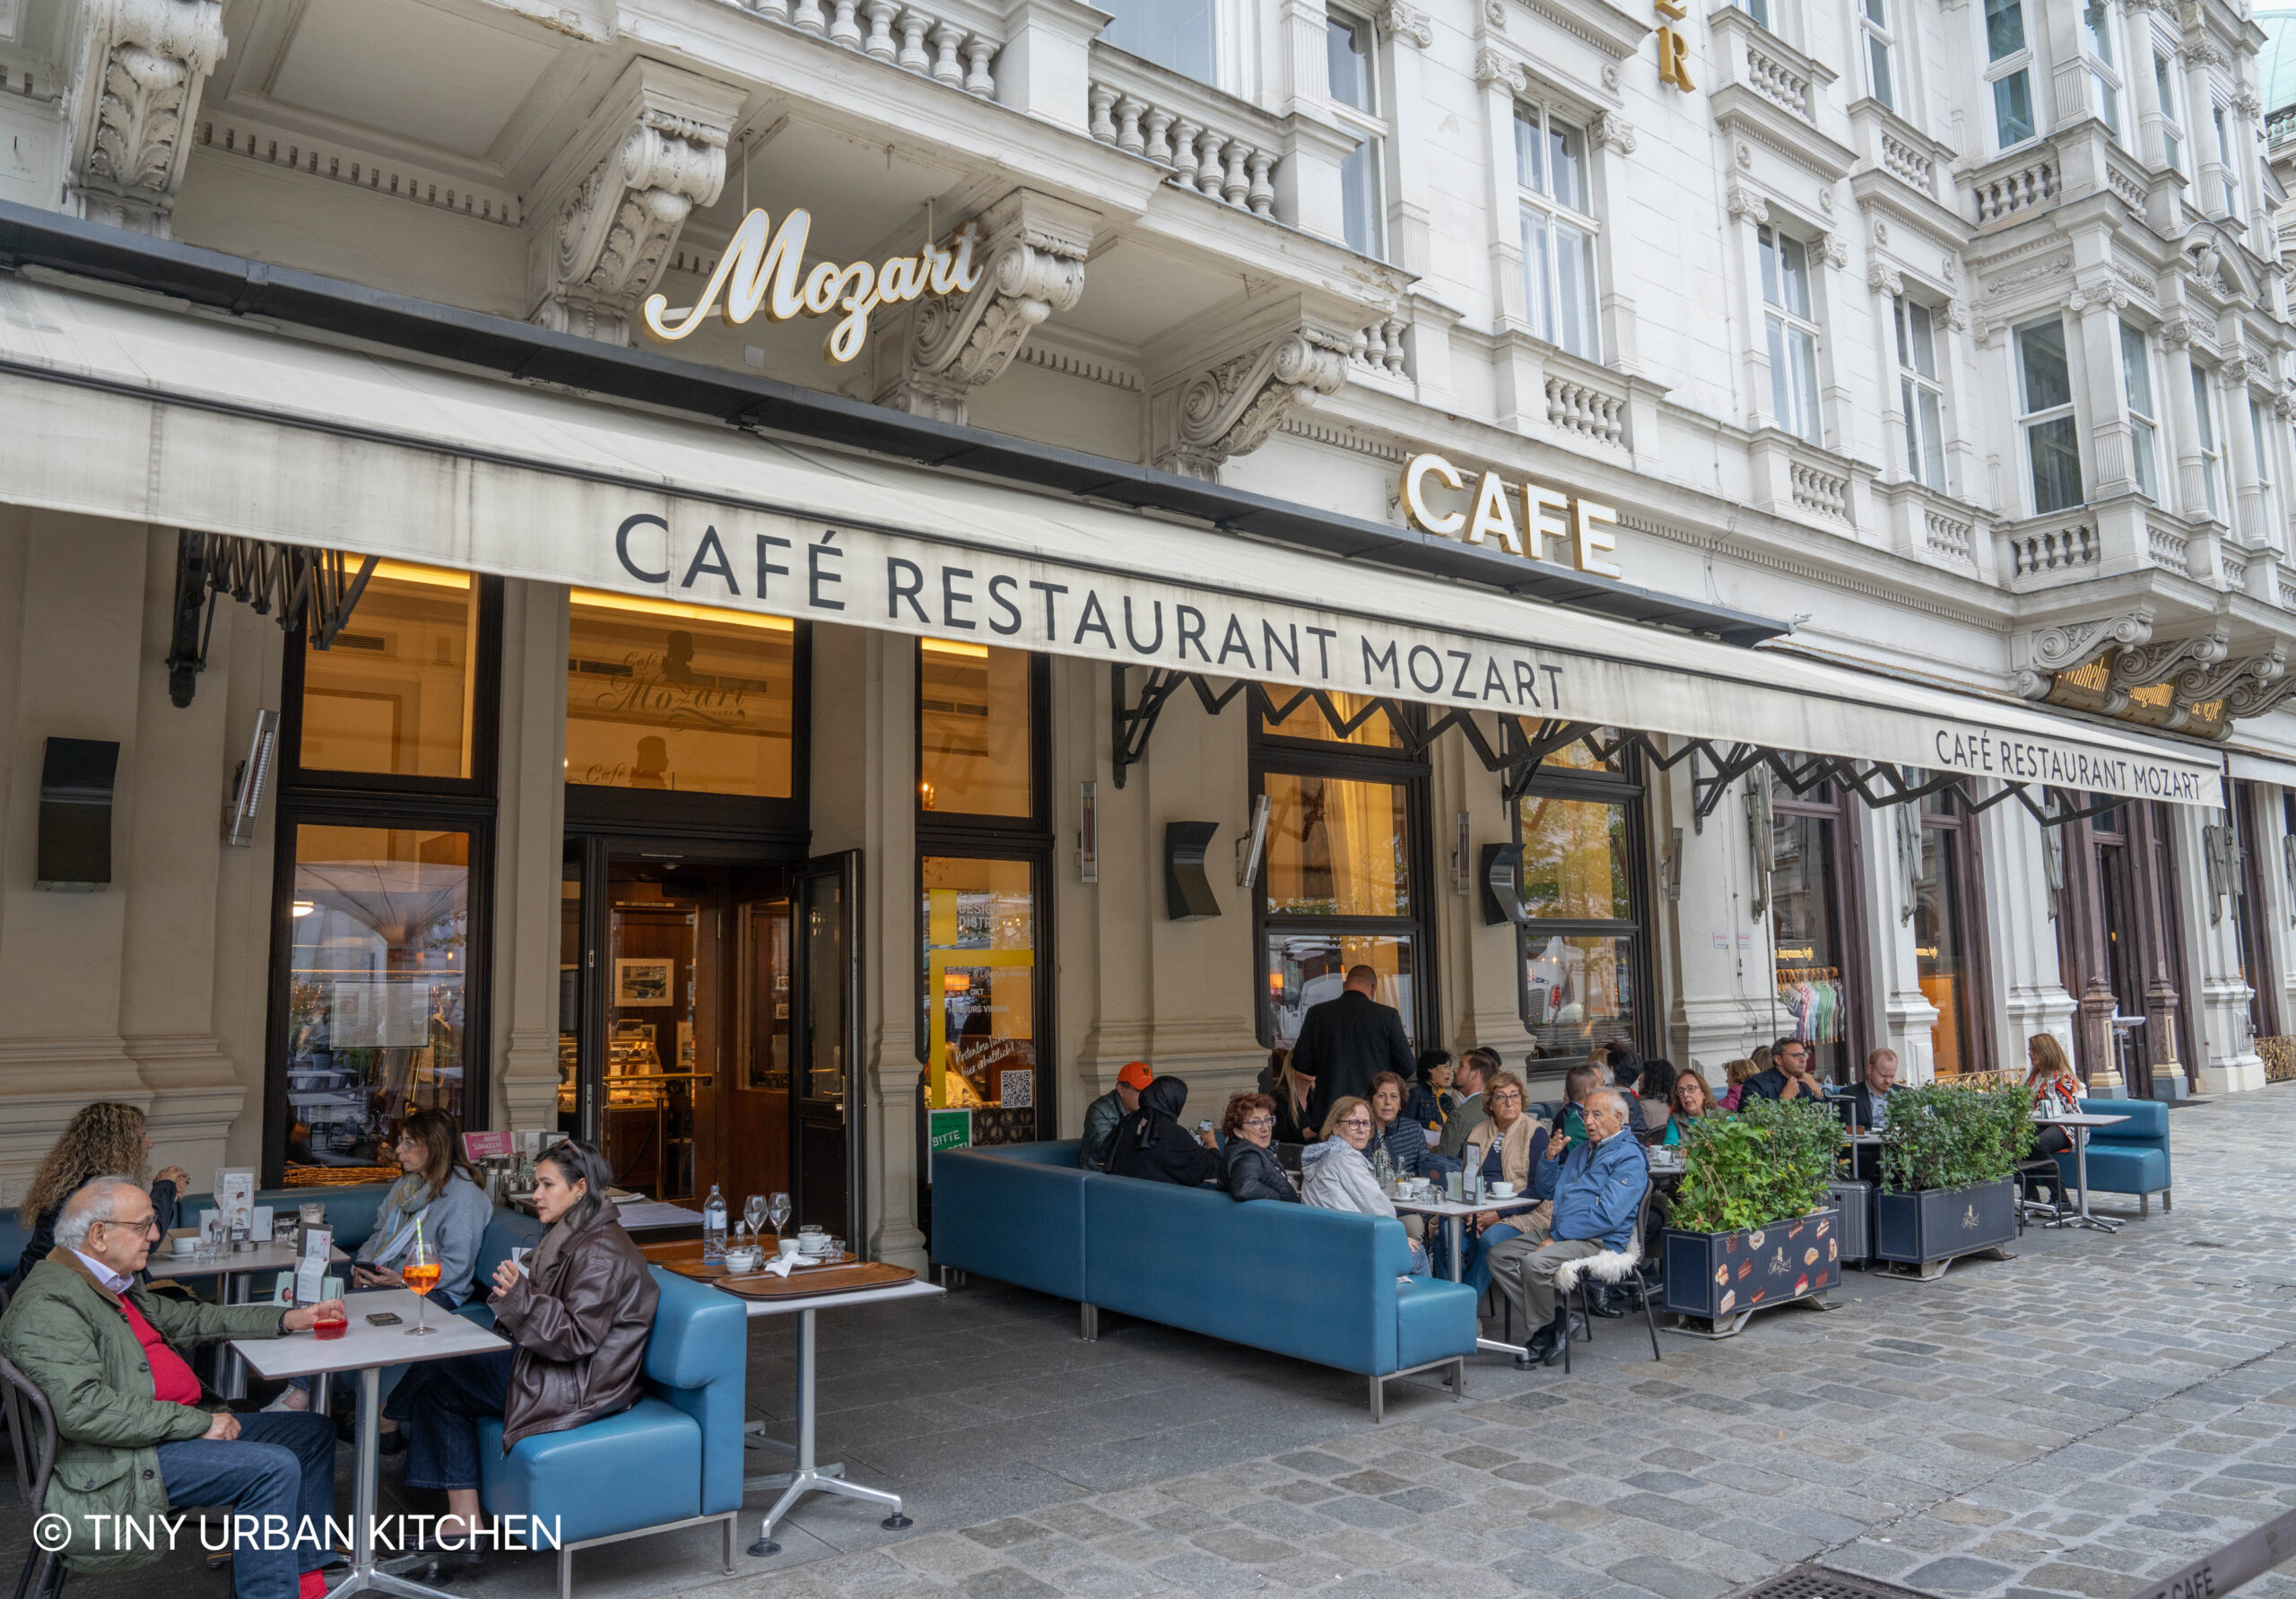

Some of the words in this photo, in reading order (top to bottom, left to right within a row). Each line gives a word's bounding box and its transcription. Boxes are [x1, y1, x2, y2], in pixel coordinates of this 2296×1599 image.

[639, 207, 984, 366] Mozart
[1399, 453, 1622, 579] CAFE
[615, 513, 846, 611] CAFÉ
[886, 556, 1337, 679] RESTAURANT
[1361, 635, 1563, 709] MOZART
[1936, 730, 1993, 770] CAFÉ
[2000, 741, 2126, 790] RESTAURANT
[2133, 764, 2199, 800] MOZART
[958, 903, 1000, 915] DESIGN
[970, 988, 984, 996] OKT
[932, 1129, 961, 1147] BITTE
